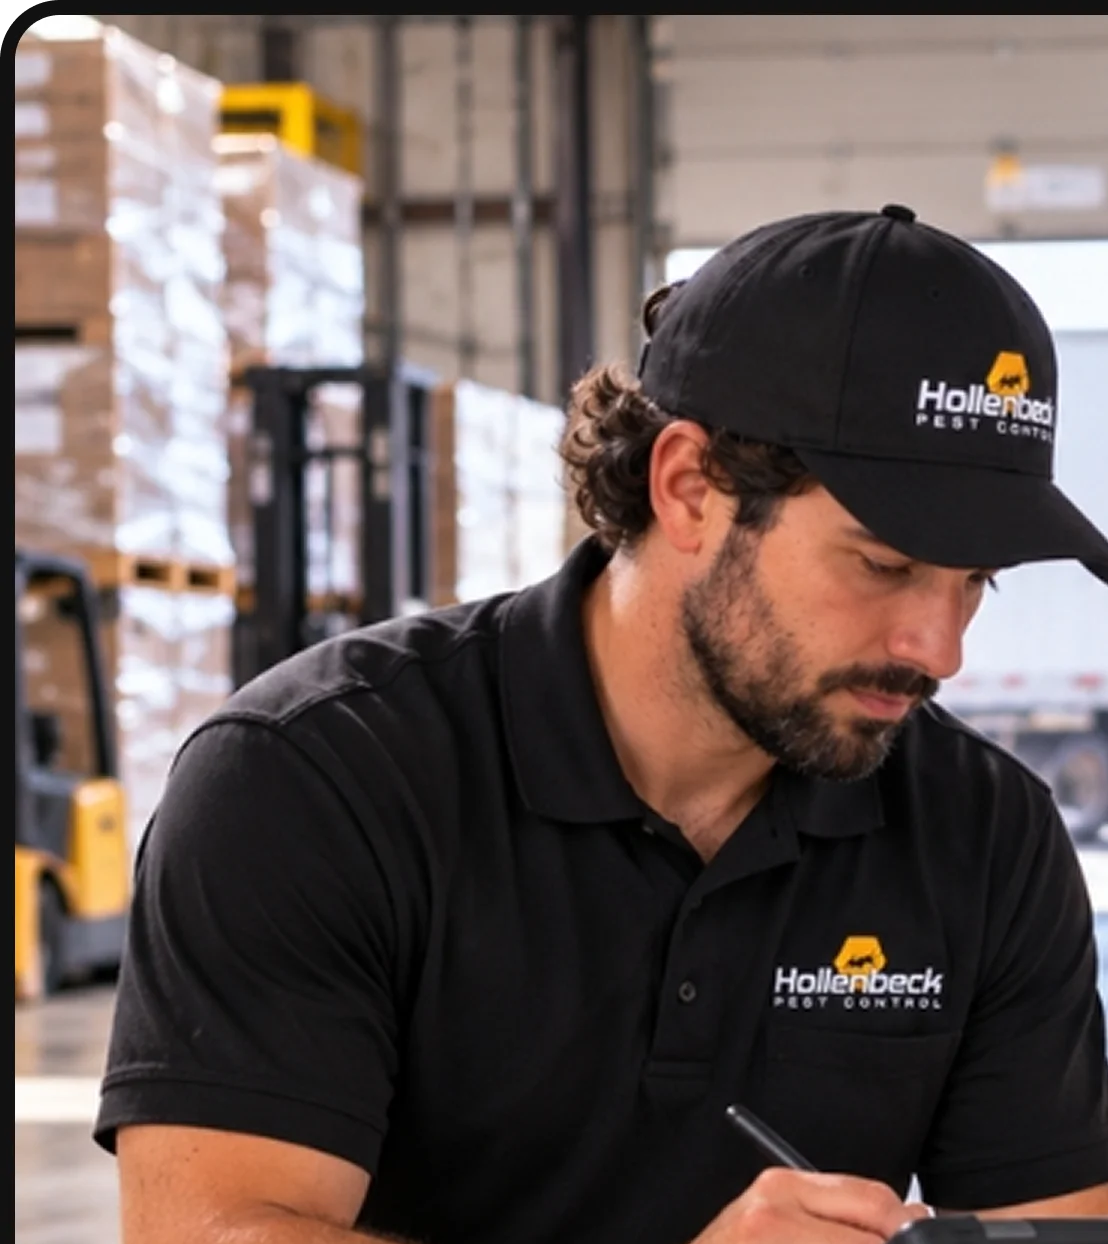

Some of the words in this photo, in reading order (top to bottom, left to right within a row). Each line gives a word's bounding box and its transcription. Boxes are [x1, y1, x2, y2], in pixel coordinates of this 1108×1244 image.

[916, 413, 980, 430] PEST
[774, 967, 943, 994] Hollenbeck
[774, 996, 828, 1009] PEST
[844, 996, 942, 1009] CONTROL
